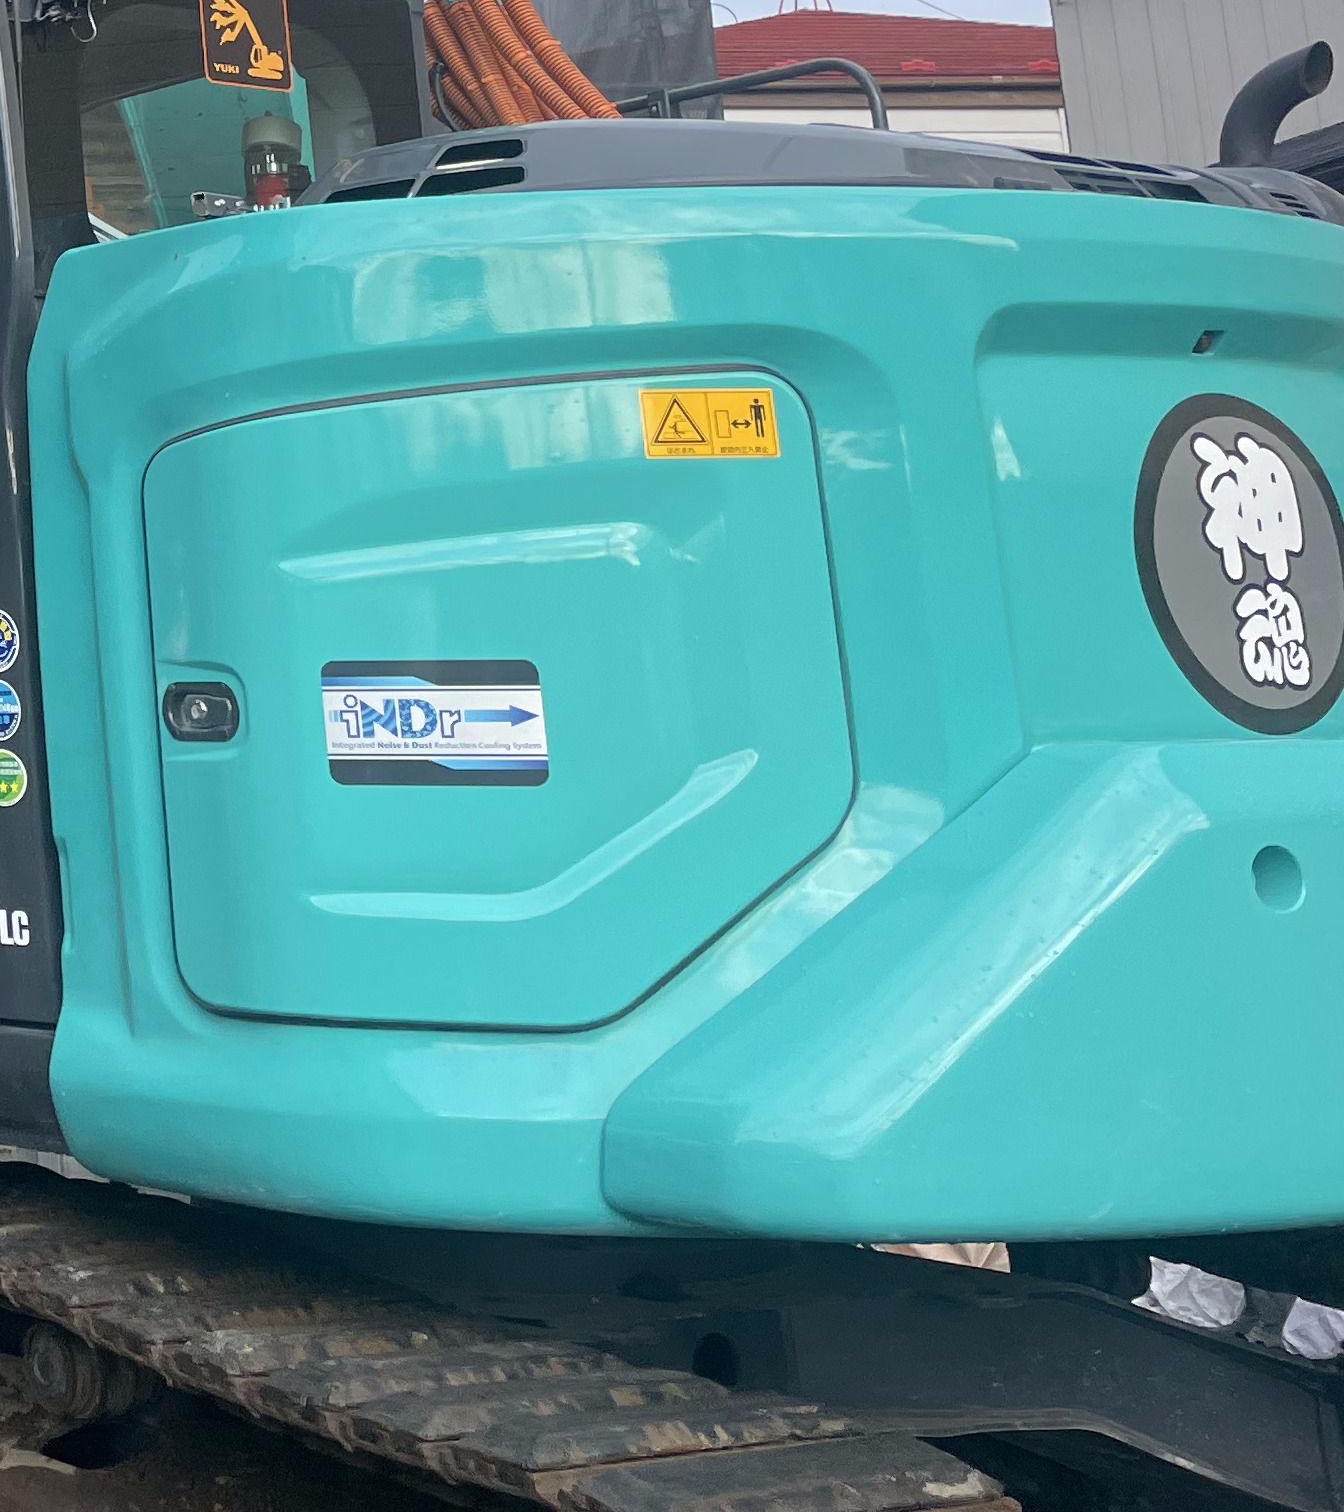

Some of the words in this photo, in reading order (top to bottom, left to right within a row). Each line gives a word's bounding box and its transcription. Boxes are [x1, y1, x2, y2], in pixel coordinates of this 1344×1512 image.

[213, 62, 240, 74] YUKI
[331, 741, 375, 751] Integrated
[377, 741, 402, 750] Noise
[412, 741, 433, 750] Dust
[434, 741, 478, 750] Reduction
[479, 741, 511, 751] Cooling
[513, 741, 542, 751] System
